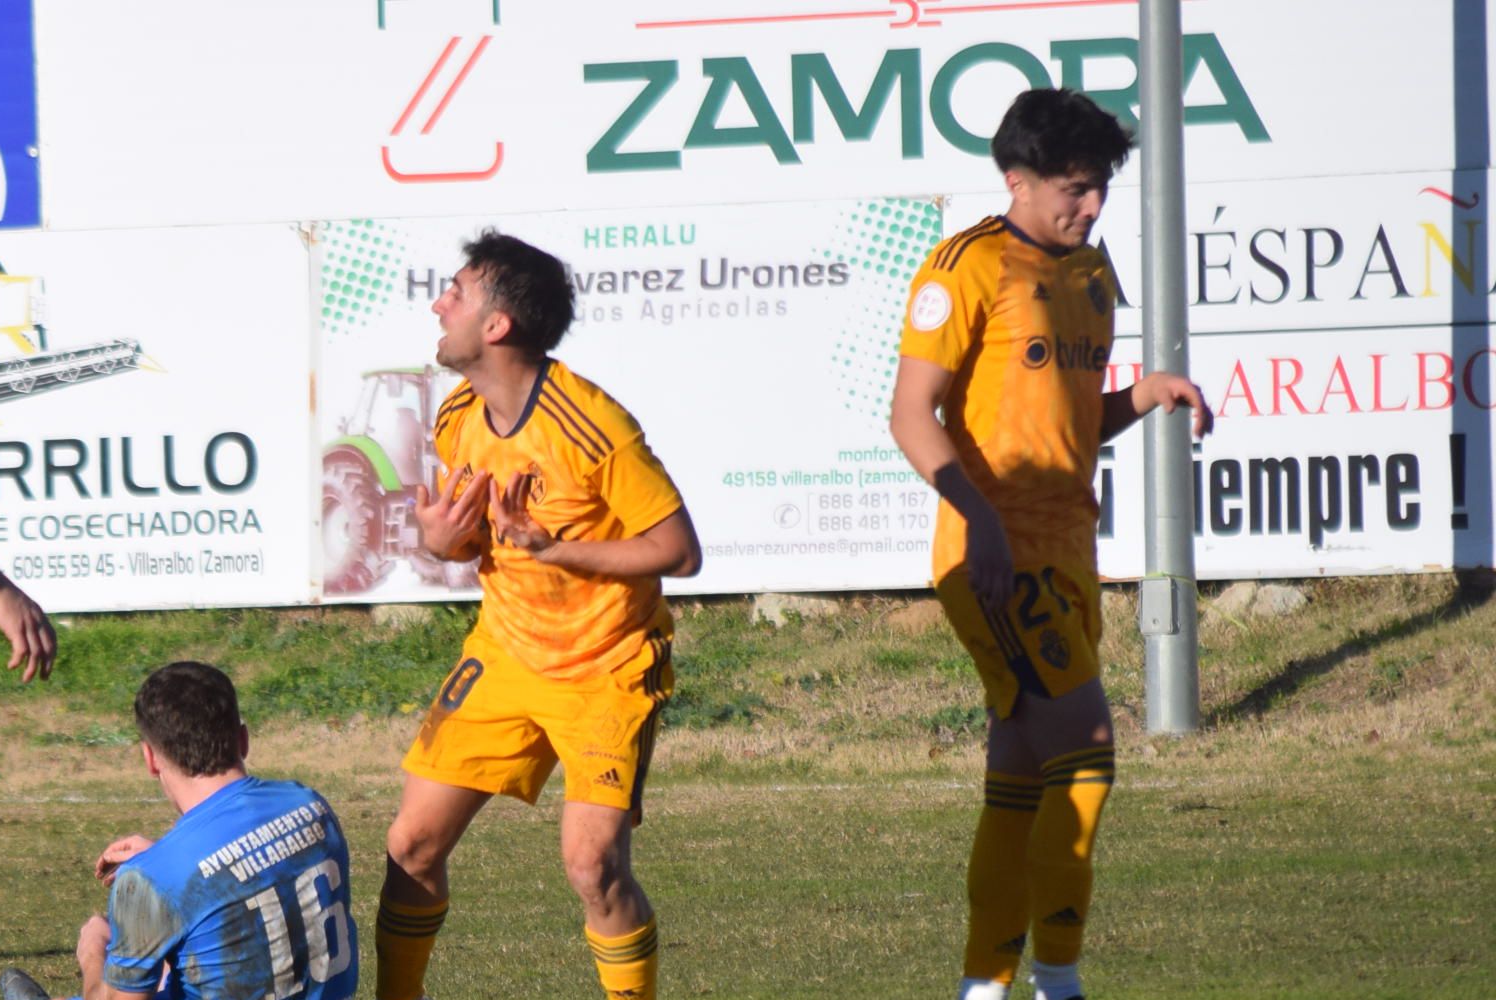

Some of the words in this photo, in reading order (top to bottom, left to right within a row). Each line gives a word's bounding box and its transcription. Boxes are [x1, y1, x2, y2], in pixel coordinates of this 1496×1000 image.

[583, 32, 1273, 175] ZAMORA
[583, 222, 698, 250] HERALU
[563, 262, 686, 296] lvarez
[699, 256, 851, 290] Urones
[639, 296, 789, 323] Agrícolas
[721, 470, 778, 488] 49159
[781, 468, 855, 488] villaralbo
[818, 492, 854, 511] 686
[858, 491, 891, 510] 481
[897, 491, 929, 509] 167
[18, 508, 264, 542] COSECHADORA
[818, 514, 854, 532] 686
[857, 513, 890, 531] 481
[896, 513, 929, 531] 170
[12, 555, 44, 580] 609
[47, 554, 67, 579] 55
[71, 553, 91, 578] 59
[95, 552, 115, 577] 45
[127, 551, 194, 577] Villaralbo
[199, 547, 264, 577] (Zamora)
[197, 805, 315, 879] AYUNTAMIENTO
[229, 822, 326, 884] VILLARALBO
